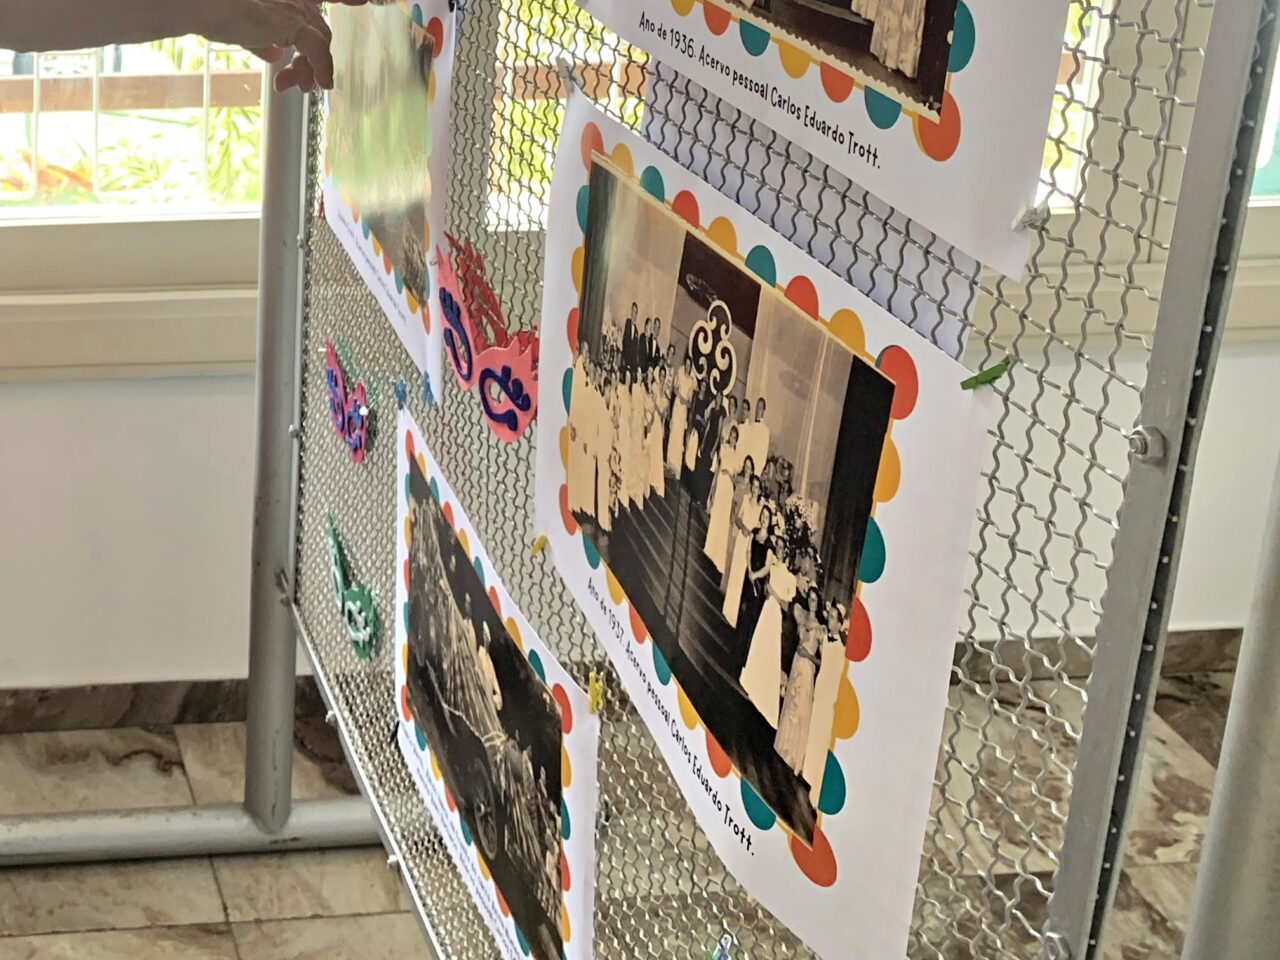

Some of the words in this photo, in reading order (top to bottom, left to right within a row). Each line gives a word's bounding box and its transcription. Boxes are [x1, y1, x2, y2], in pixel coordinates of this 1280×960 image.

[639, 11, 655, 32] Ano
[657, 23, 667, 40] de
[670, 28, 696, 59] 1936.
[699, 45, 731, 77] Acervo
[732, 69, 769, 101] pessoal
[771, 86, 801, 120] Carlos
[803, 105, 845, 145] Eduardo
[848, 131, 881, 169] Trott.
[588, 577, 599, 601] Ano
[600, 598, 607, 615] de
[625, 640, 646, 683] Acervo
[647, 683, 671, 727] pessoal
[670, 719, 691, 764] Carlos
[692, 755, 723, 812] Eduardo
[724, 804, 755, 856] Trott.
